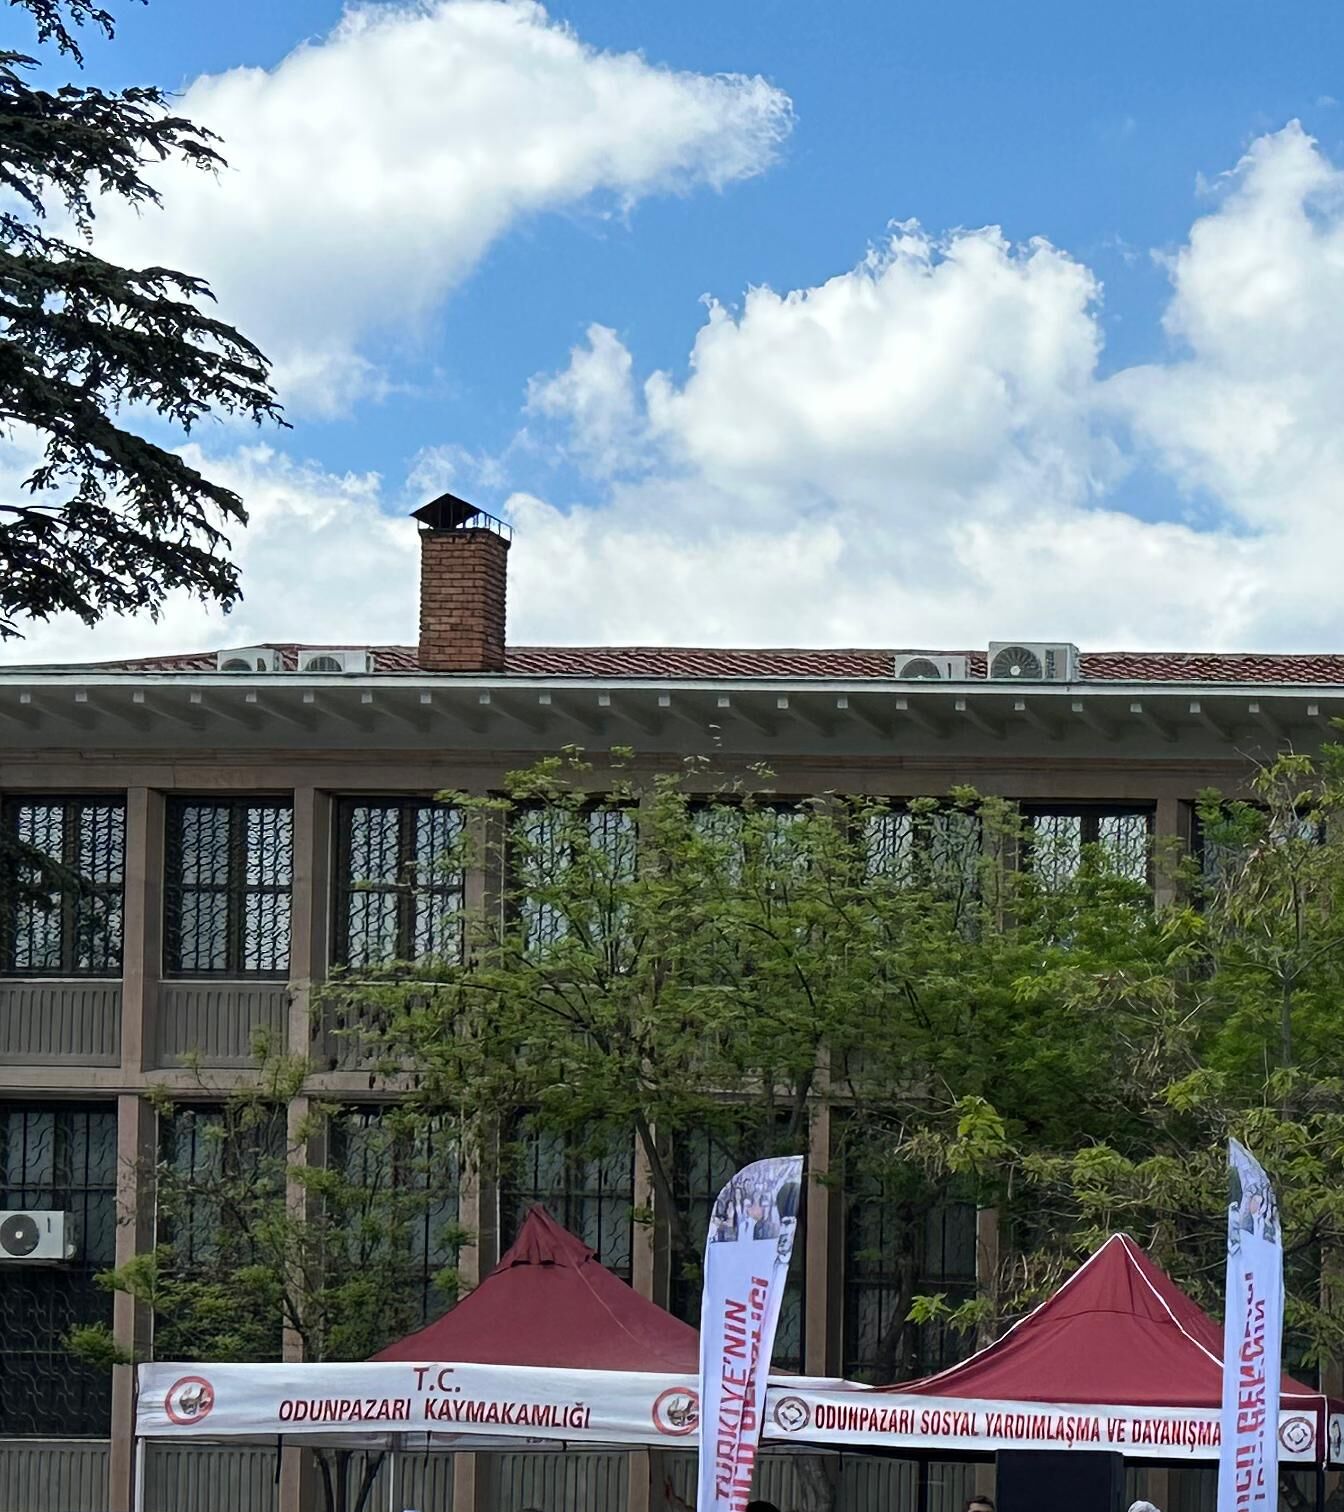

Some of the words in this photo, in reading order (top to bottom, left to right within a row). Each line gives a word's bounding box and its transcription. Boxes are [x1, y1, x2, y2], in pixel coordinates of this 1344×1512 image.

[412, 1366, 463, 1393] T.C.
[277, 1397, 413, 1423] ODUNPAZARI
[423, 1398, 592, 1430] KAYMAKAMLIĞI
[814, 1403, 915, 1435] ODUNPAZARI
[920, 1409, 980, 1438] SOSYAL
[985, 1412, 1101, 1449] YARDIMLAŞMA
[1107, 1417, 1126, 1443] VE
[1131, 1418, 1222, 1453] DAYANIŞMA
